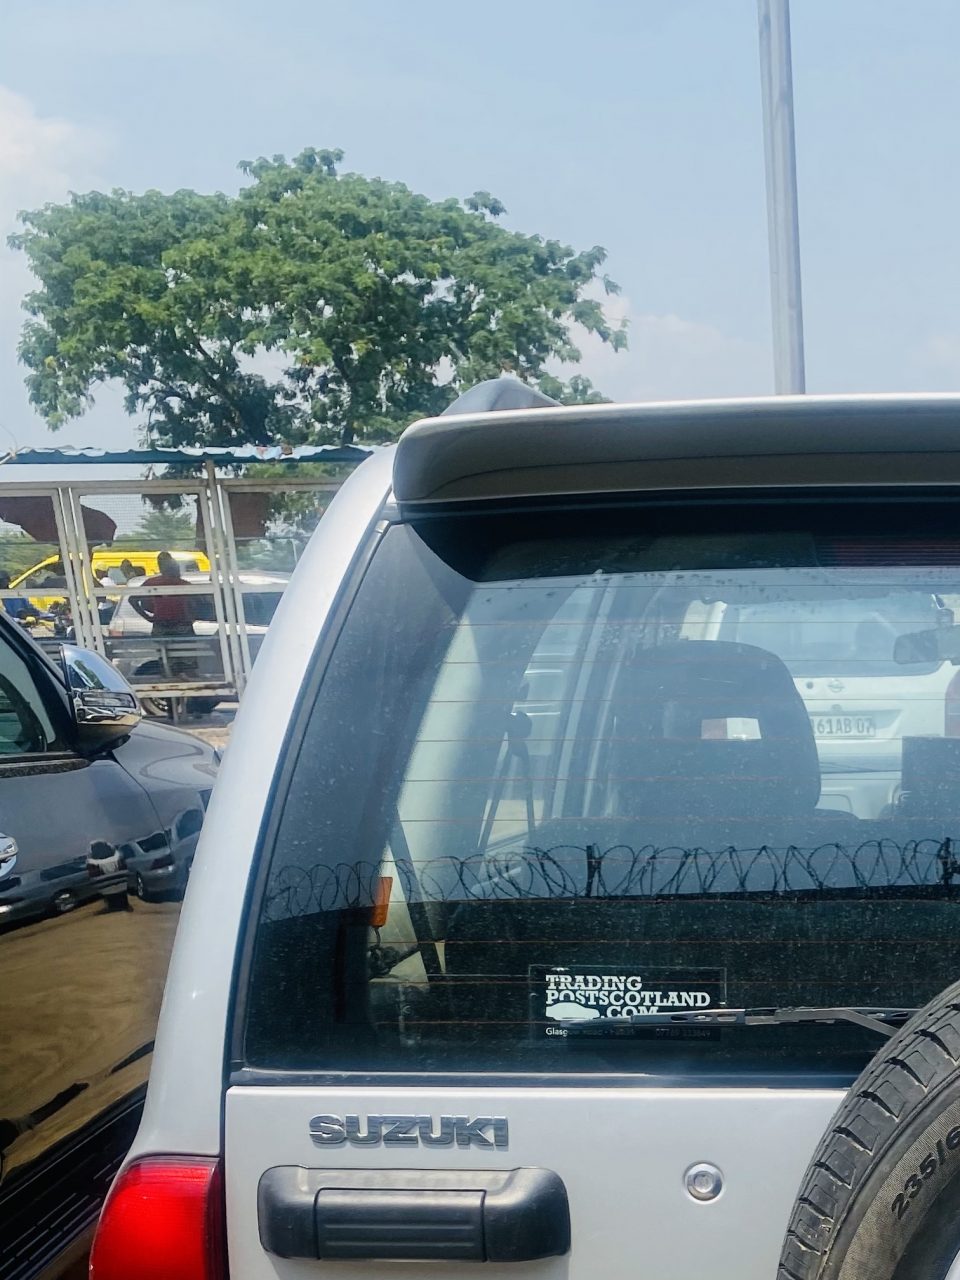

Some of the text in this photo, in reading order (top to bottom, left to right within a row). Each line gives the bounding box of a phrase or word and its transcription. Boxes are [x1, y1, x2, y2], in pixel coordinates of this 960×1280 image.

[545, 975, 642, 991] TRADING
[545, 990, 711, 1007] POSTSCOTLAND
[308, 1113, 510, 1147] SUZUKI
